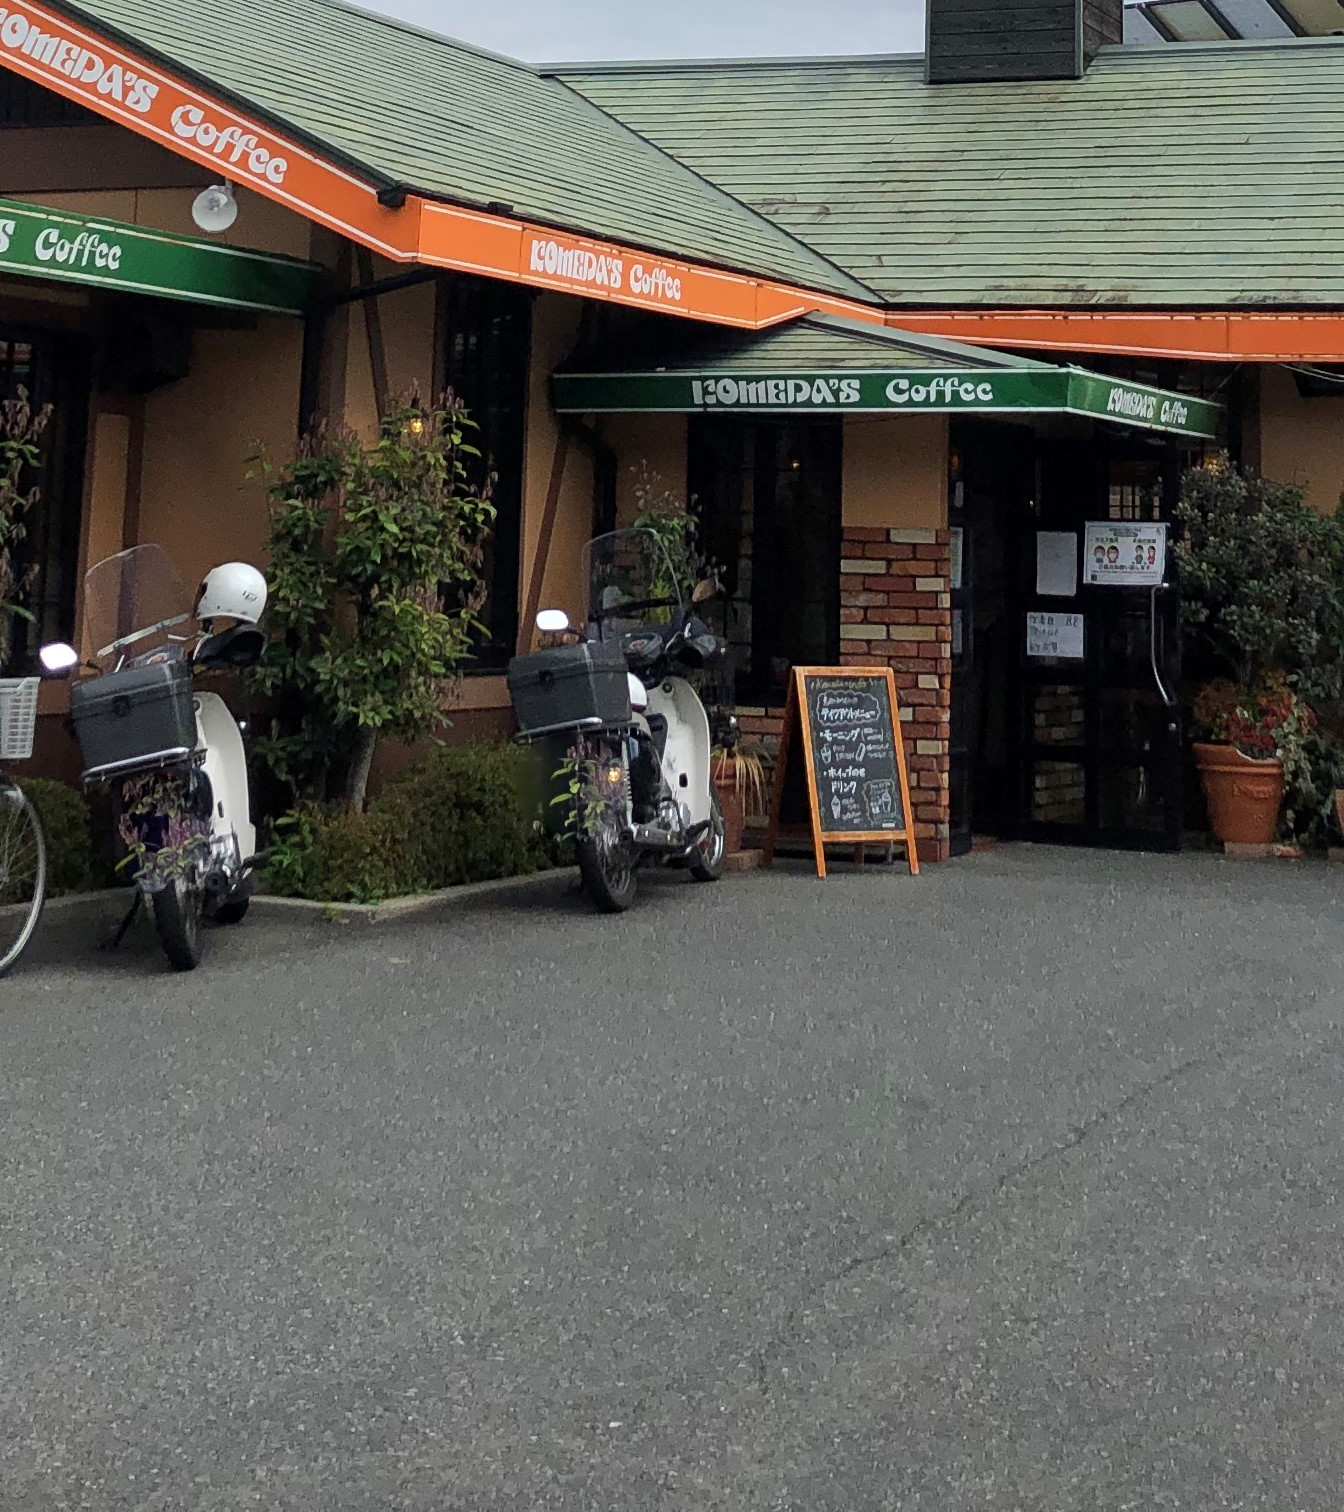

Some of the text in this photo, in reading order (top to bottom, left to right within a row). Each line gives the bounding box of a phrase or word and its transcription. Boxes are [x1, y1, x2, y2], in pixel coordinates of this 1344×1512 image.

[170, 104, 288, 184] Coffee
[34, 228, 122, 271] Coffee
[530, 239, 682, 301] KOMEDA'S Coffee
[691, 376, 994, 405] KOMEDA'S Coffee
[1106, 387, 1156, 419] KOMEDA'S
